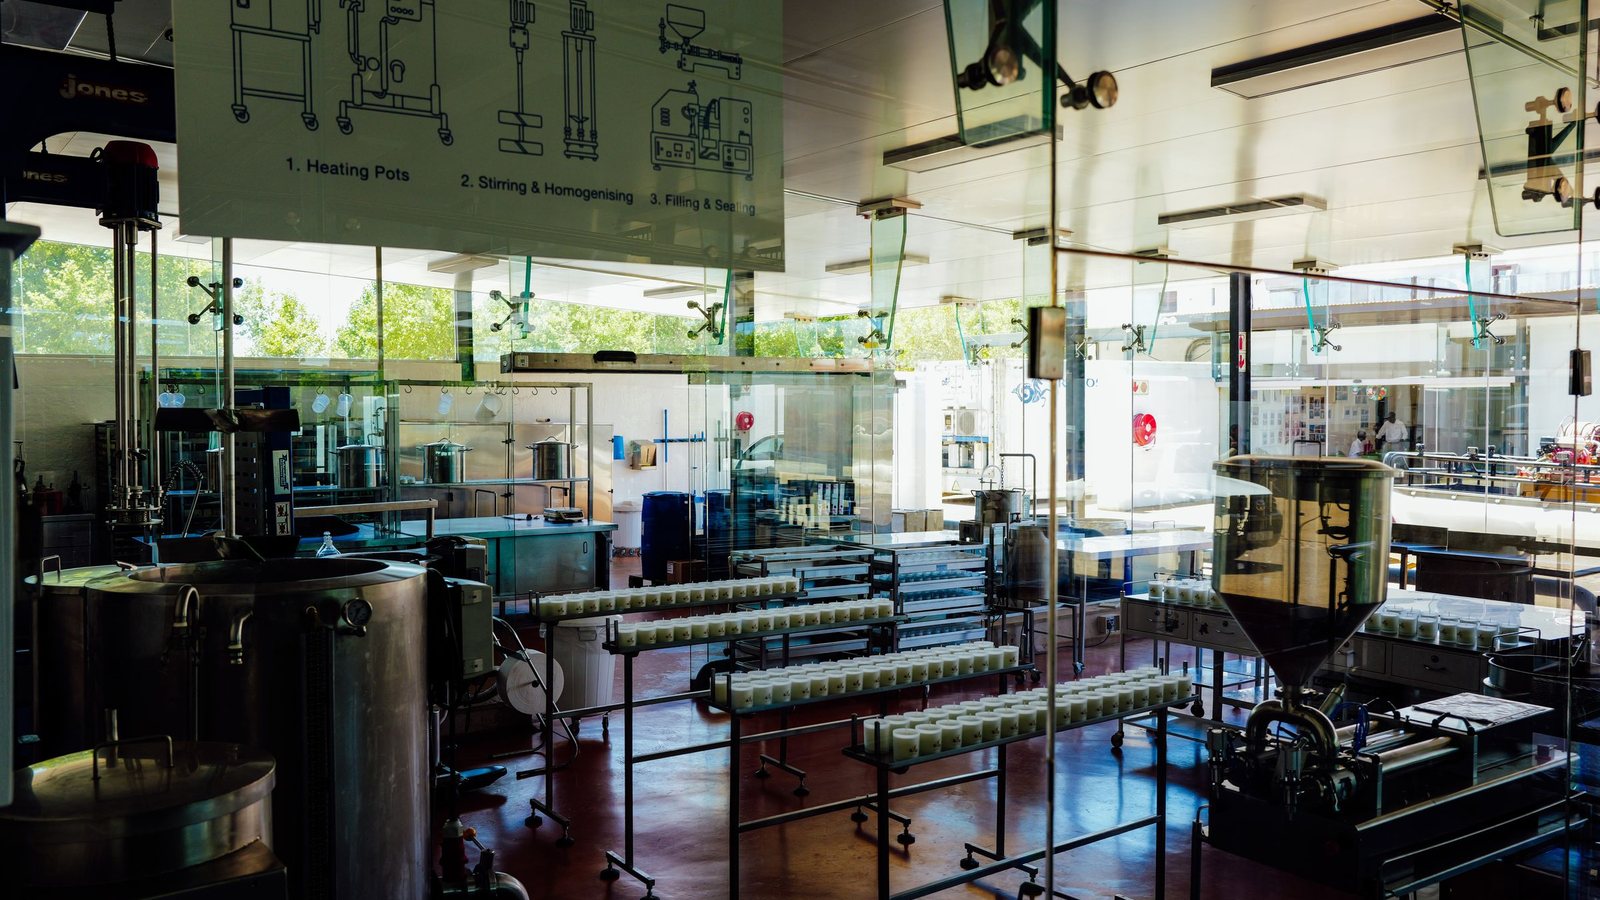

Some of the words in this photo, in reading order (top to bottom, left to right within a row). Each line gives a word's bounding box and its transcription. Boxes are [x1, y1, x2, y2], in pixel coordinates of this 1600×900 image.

[22, 169, 67, 183] nes
[286, 157, 300, 171] 1.
[307, 159, 369, 181] Heating
[375, 165, 410, 182] Pots
[461, 174, 474, 188] 2.
[478, 175, 527, 196] Stirring
[531, 181, 541, 194] &
[544, 182, 634, 206] Homogenising
[650, 193, 661, 205] 3.
[665, 194, 700, 212] Filling
[703, 198, 711, 210] &
[715, 199, 756, 217] Sealing
